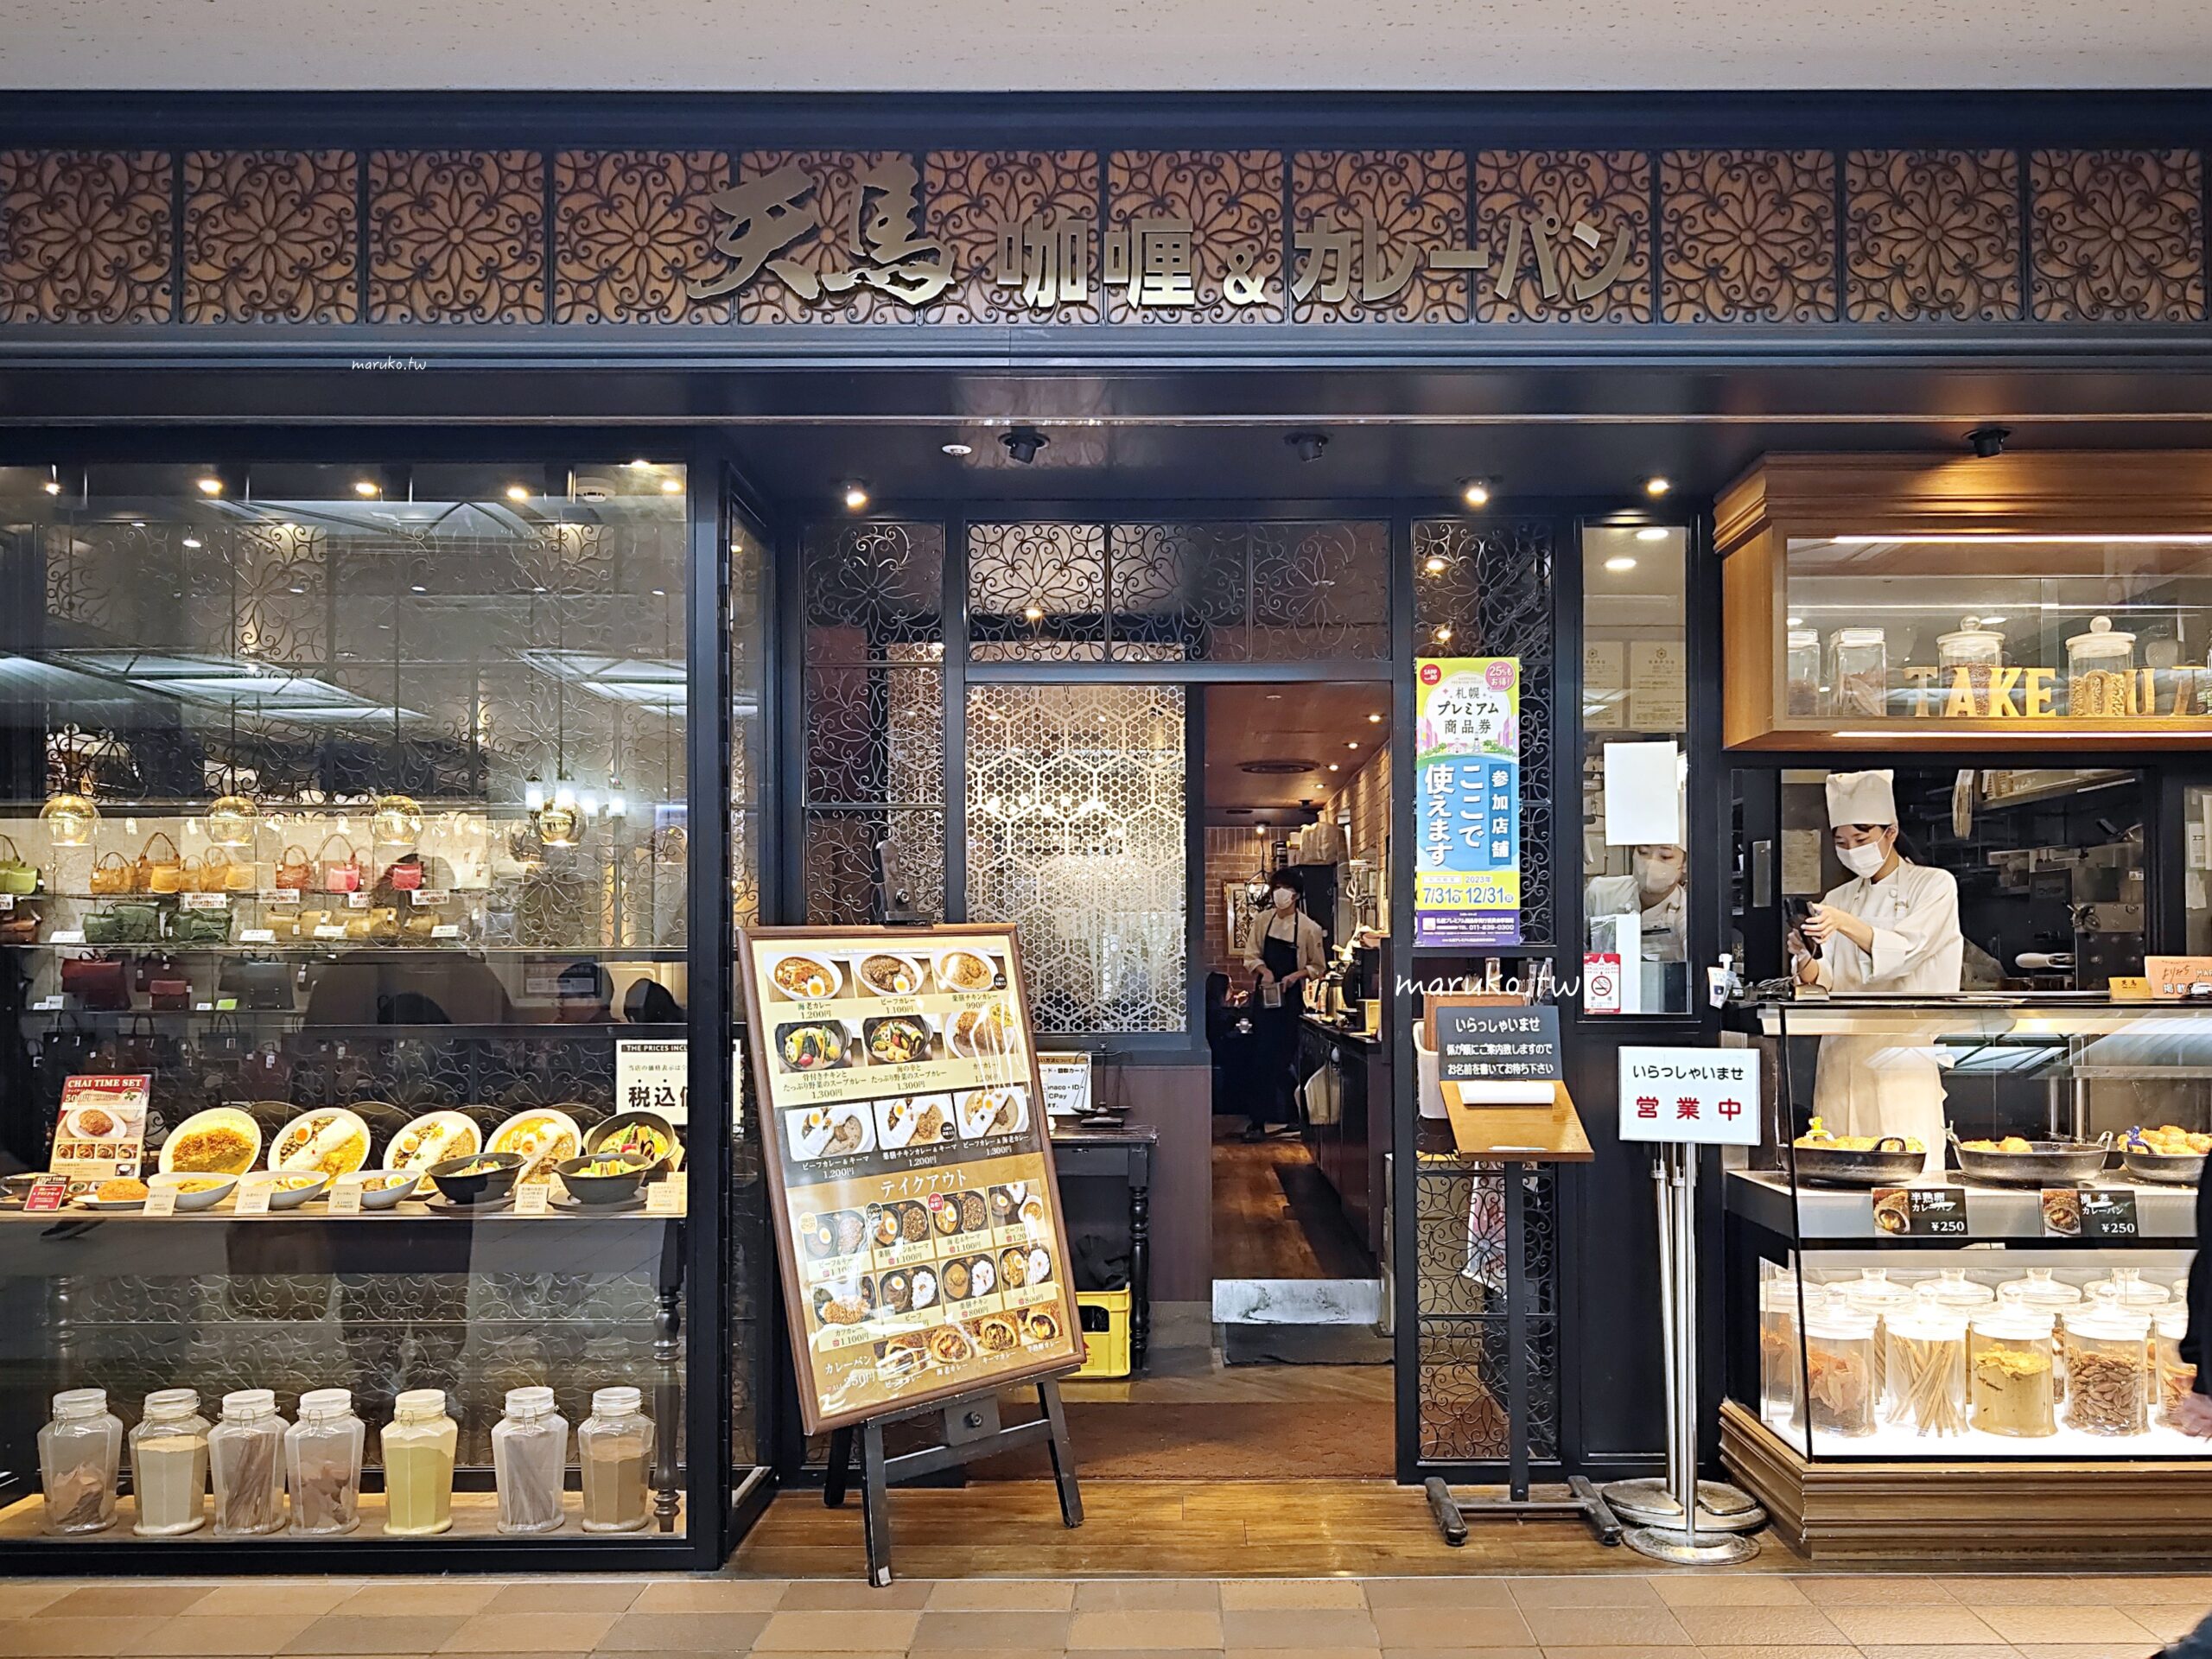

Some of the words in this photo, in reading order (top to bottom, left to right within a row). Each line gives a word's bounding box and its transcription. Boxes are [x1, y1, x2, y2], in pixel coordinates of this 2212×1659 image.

[1222, 250, 1269, 306] &
[1289, 213, 1634, 304] カレーパン
[1455, 687, 1479, 699] 札幌
[1904, 666, 2057, 718] TAKE
[1437, 700, 1499, 715] プレミアム
[1444, 719, 1491, 734] 商品券
[1459, 765, 1484, 848] ここで
[1424, 763, 1455, 866] 使えます
[1491, 770, 1510, 860] 参加店舗
[1455, 1017, 1541, 1033] いらっしゃいませ
[67, 1079, 92, 1088] CHAI
[122, 1078, 143, 1087] SET
[897, 1080, 926, 1091] 1,300円
[811, 1089, 843, 1100] 1,300円
[1636, 1096, 1742, 1121] 営業中
[908, 1156, 938, 1167] 1,200円
[823, 1167, 855, 1179] 1,200円
[880, 1169, 967, 1198] テイクアウト
[1930, 1221, 1965, 1232] ¥250
[2101, 1223, 2136, 1234] ¥250
[968, 1307, 989, 1318] 800円
[824, 1356, 872, 1376] カレーパン
